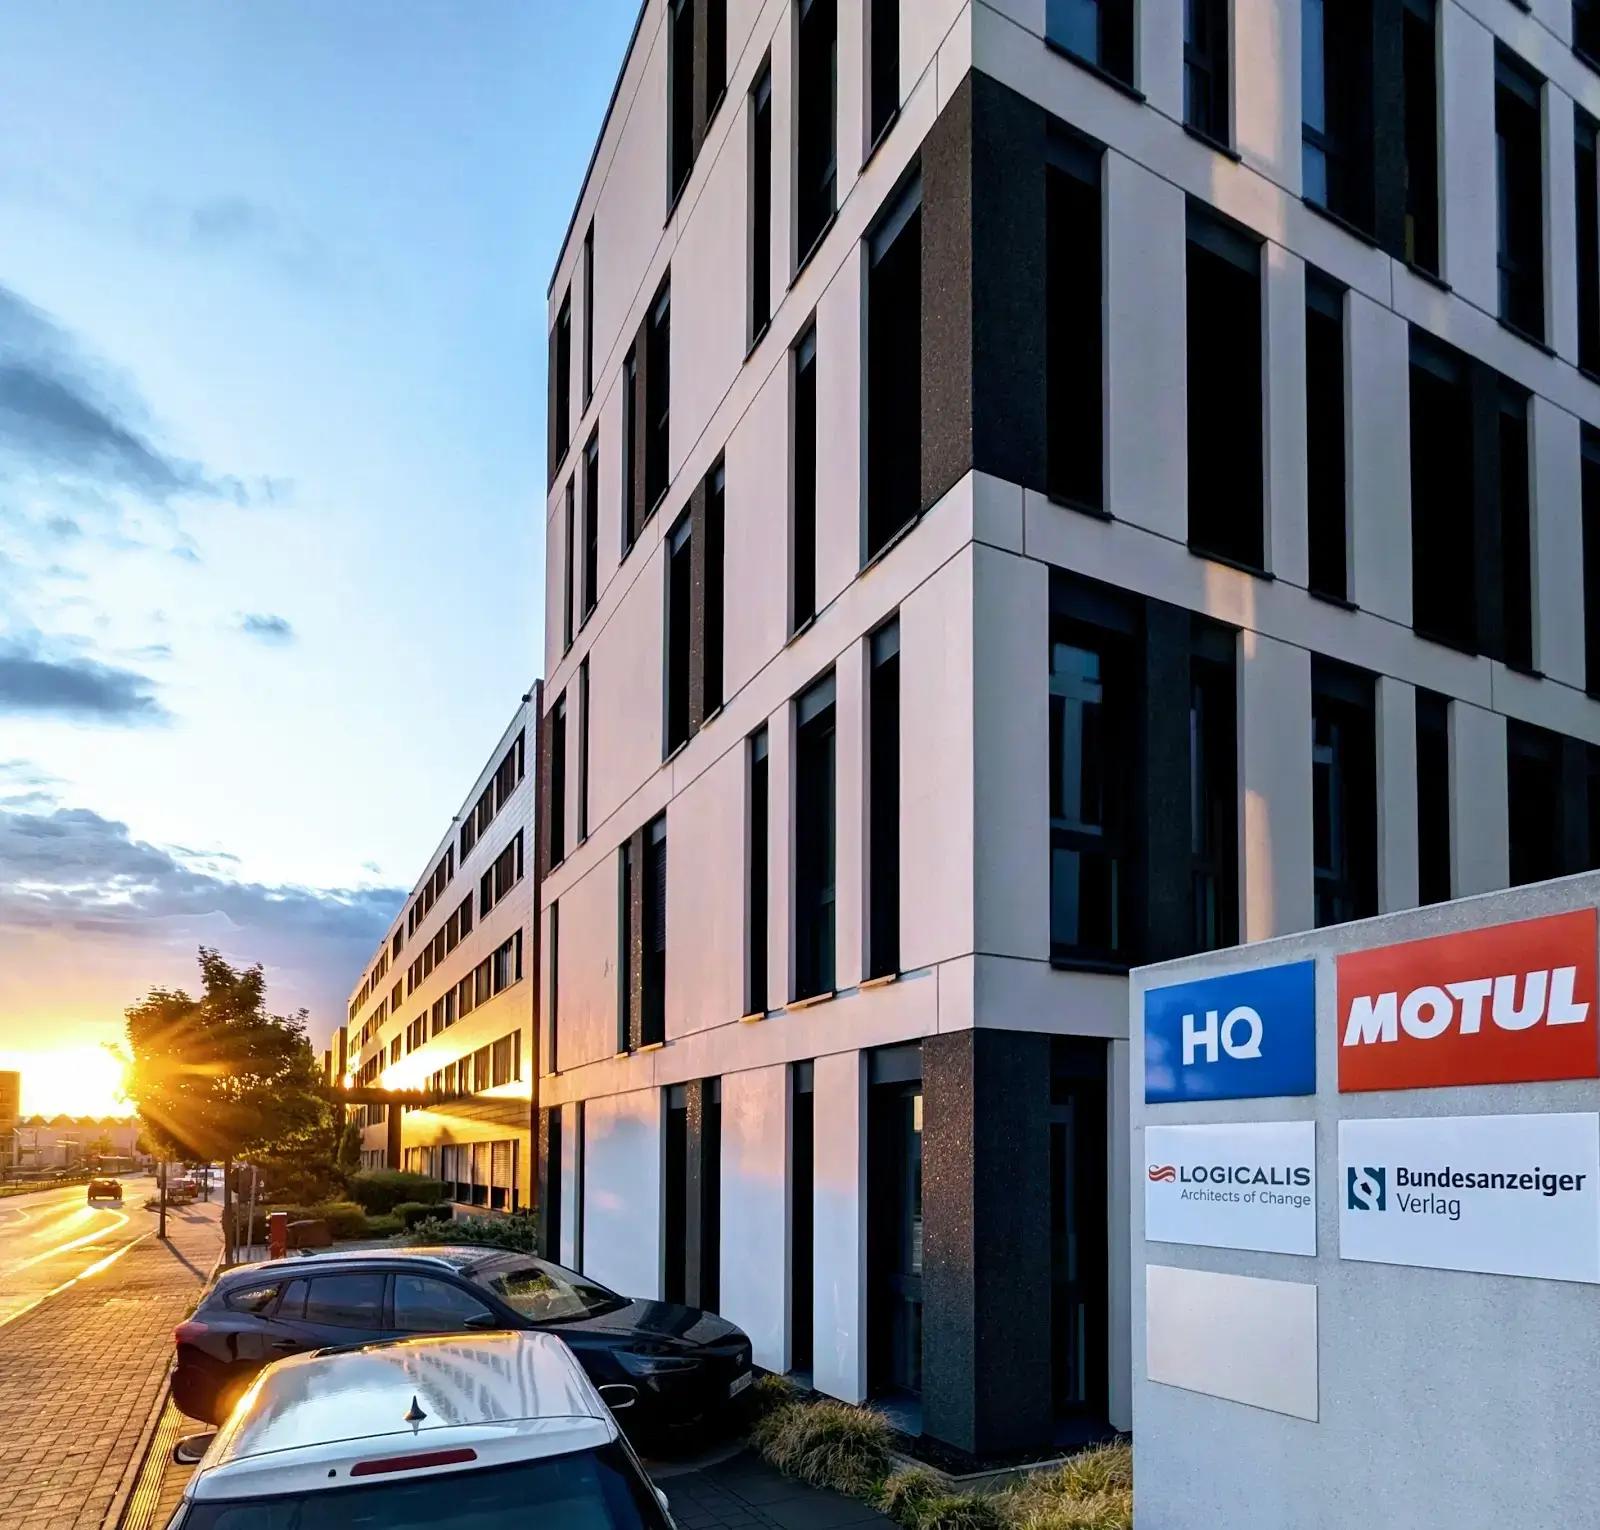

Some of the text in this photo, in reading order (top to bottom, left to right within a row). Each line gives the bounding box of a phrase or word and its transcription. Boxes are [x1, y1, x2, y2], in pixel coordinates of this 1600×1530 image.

[1343, 966, 1589, 1046] MOTUL
[1183, 1006, 1262, 1065] HQ
[1180, 1165, 1311, 1187] LOGICALIS
[1397, 1166, 1587, 1198] Bundesanzeiger
[1180, 1188, 1311, 1209] Architects of Change
[1397, 1192, 1461, 1221] Verlag
